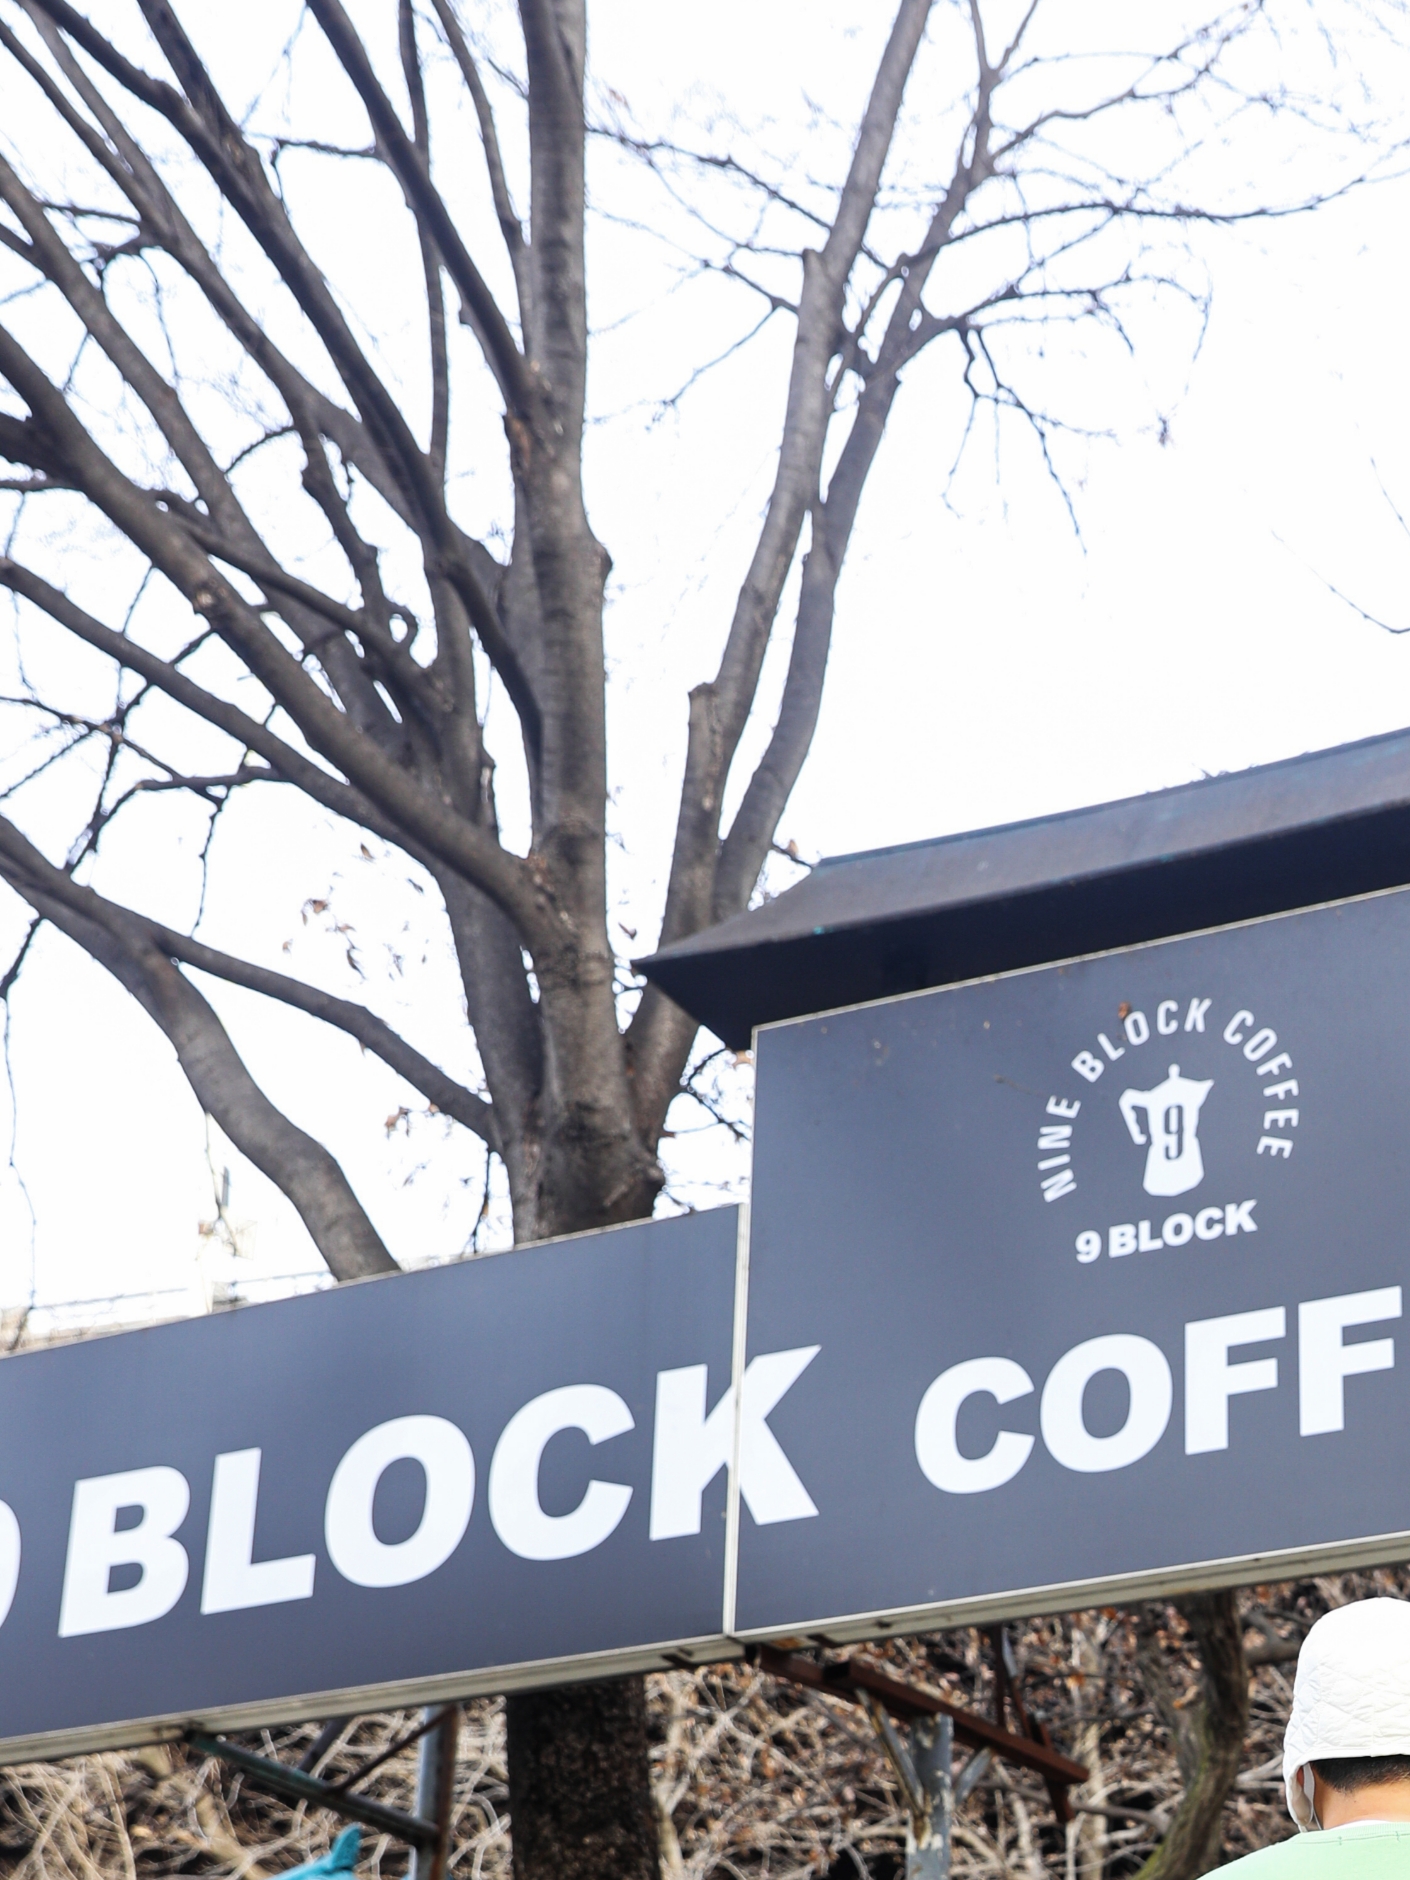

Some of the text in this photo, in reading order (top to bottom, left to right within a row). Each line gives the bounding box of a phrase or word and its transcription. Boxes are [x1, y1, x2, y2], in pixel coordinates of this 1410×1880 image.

[1037, 998, 1299, 1202] NINE BLOCK COFFEE
[1164, 1104, 1184, 1161] 9
[1075, 1199, 1258, 1264] 9 BLOCK
[58, 1344, 822, 1638] BLOCK
